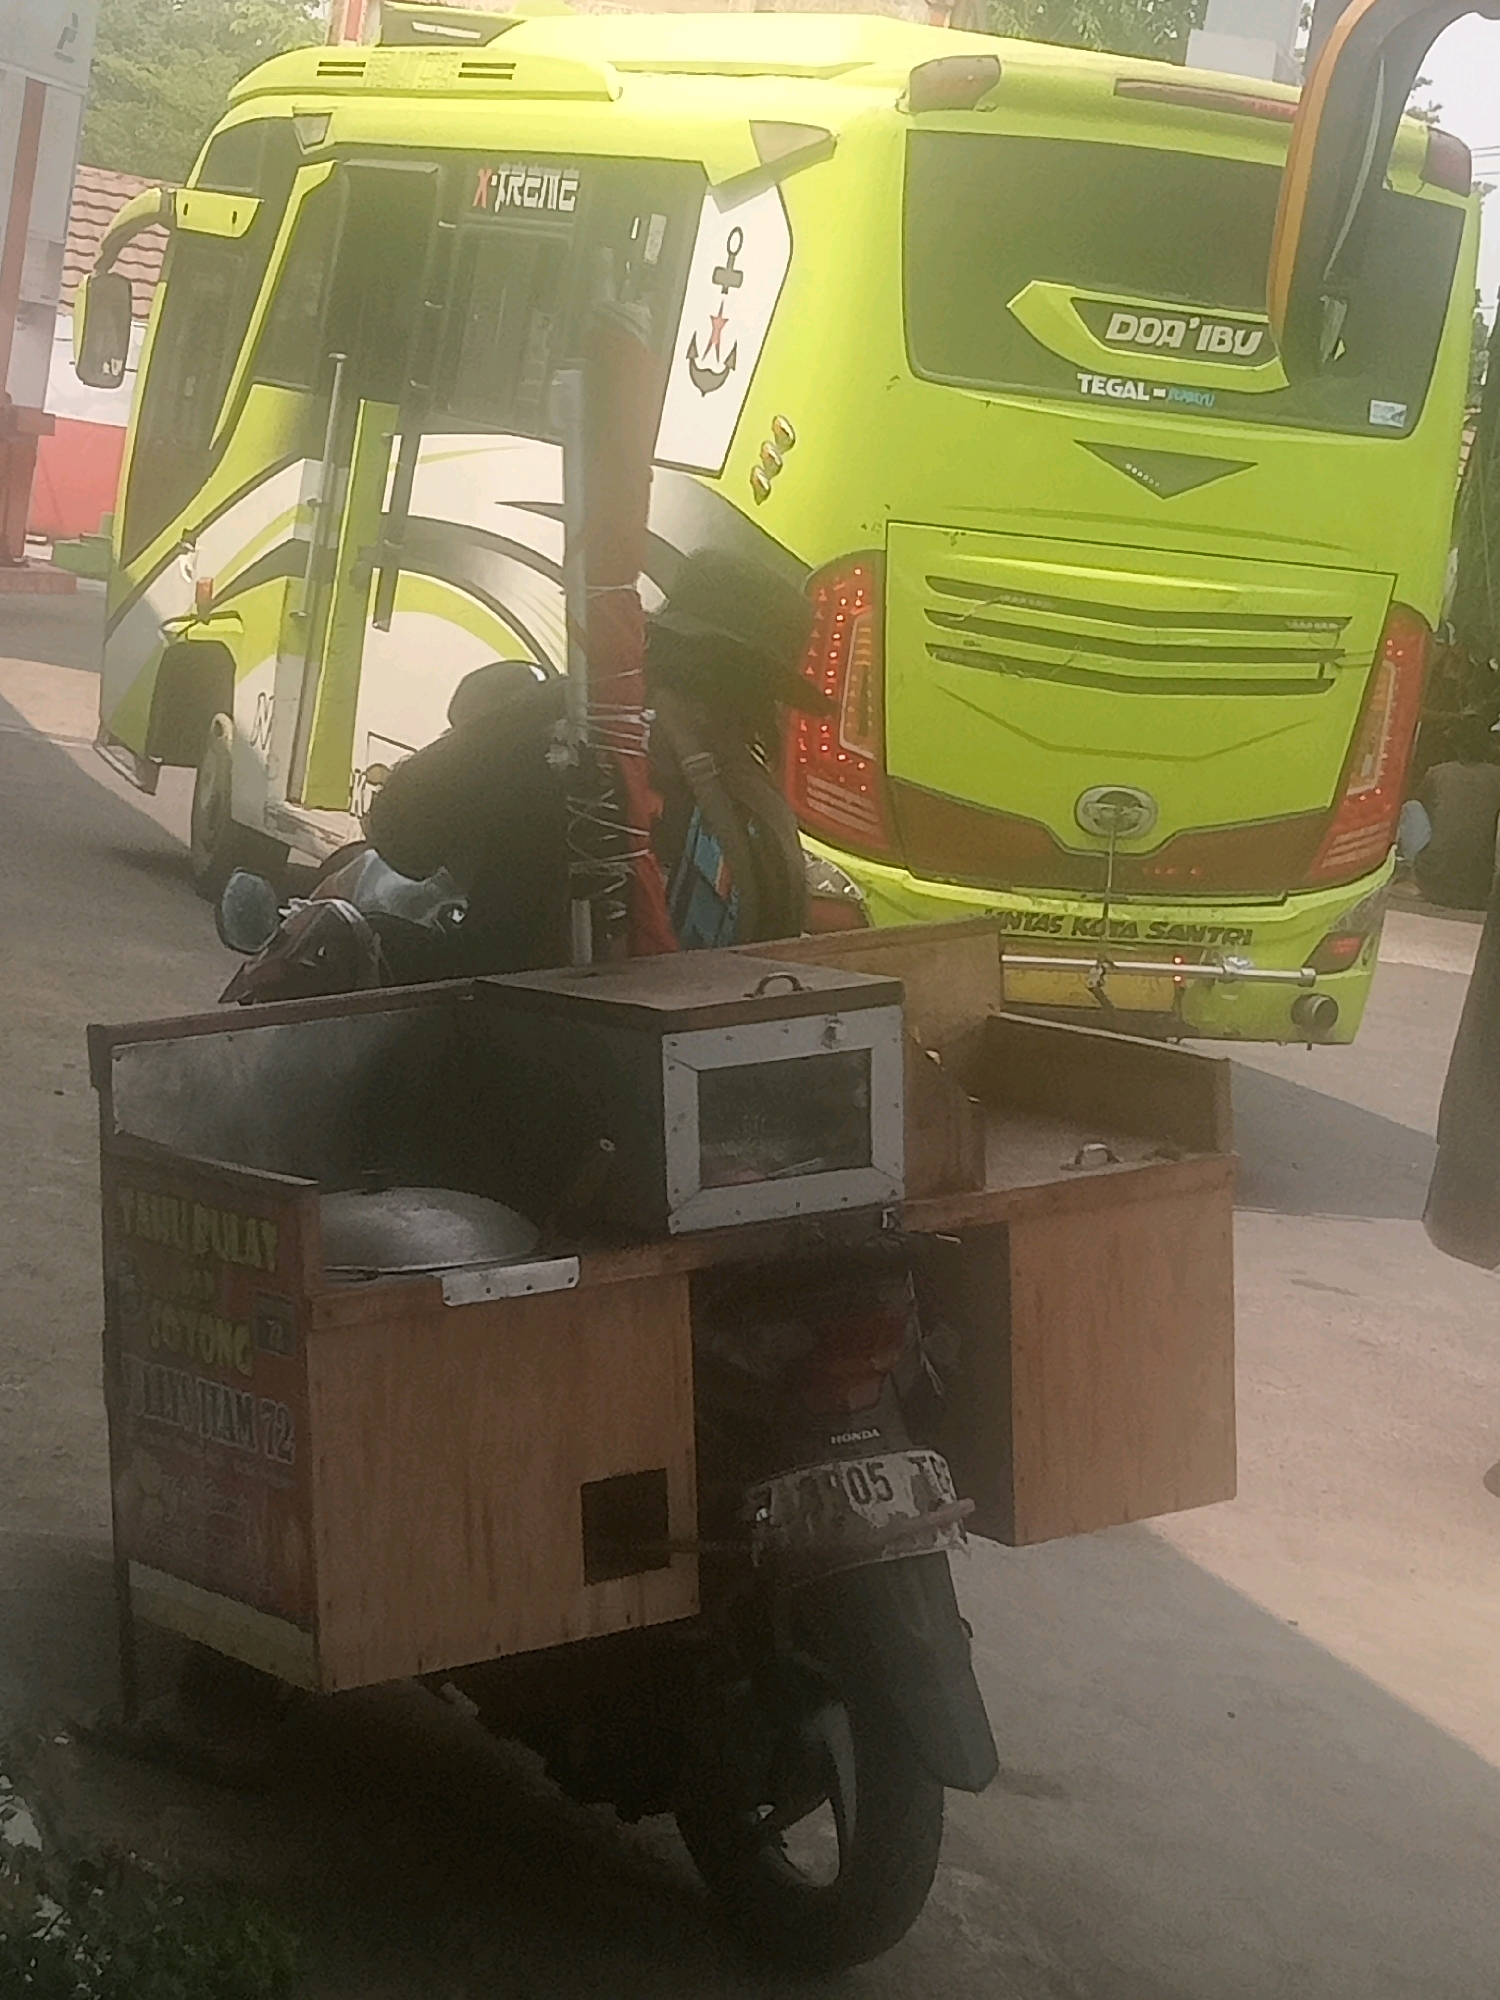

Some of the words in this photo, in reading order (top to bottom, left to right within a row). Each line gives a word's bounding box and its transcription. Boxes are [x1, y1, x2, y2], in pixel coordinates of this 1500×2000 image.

[1071, 916, 1139, 940] KOTA
[1149, 921, 1254, 946] SANTRI
[260, 1396, 296, 1466] 72
[830, 1428, 881, 1444] HONDA
